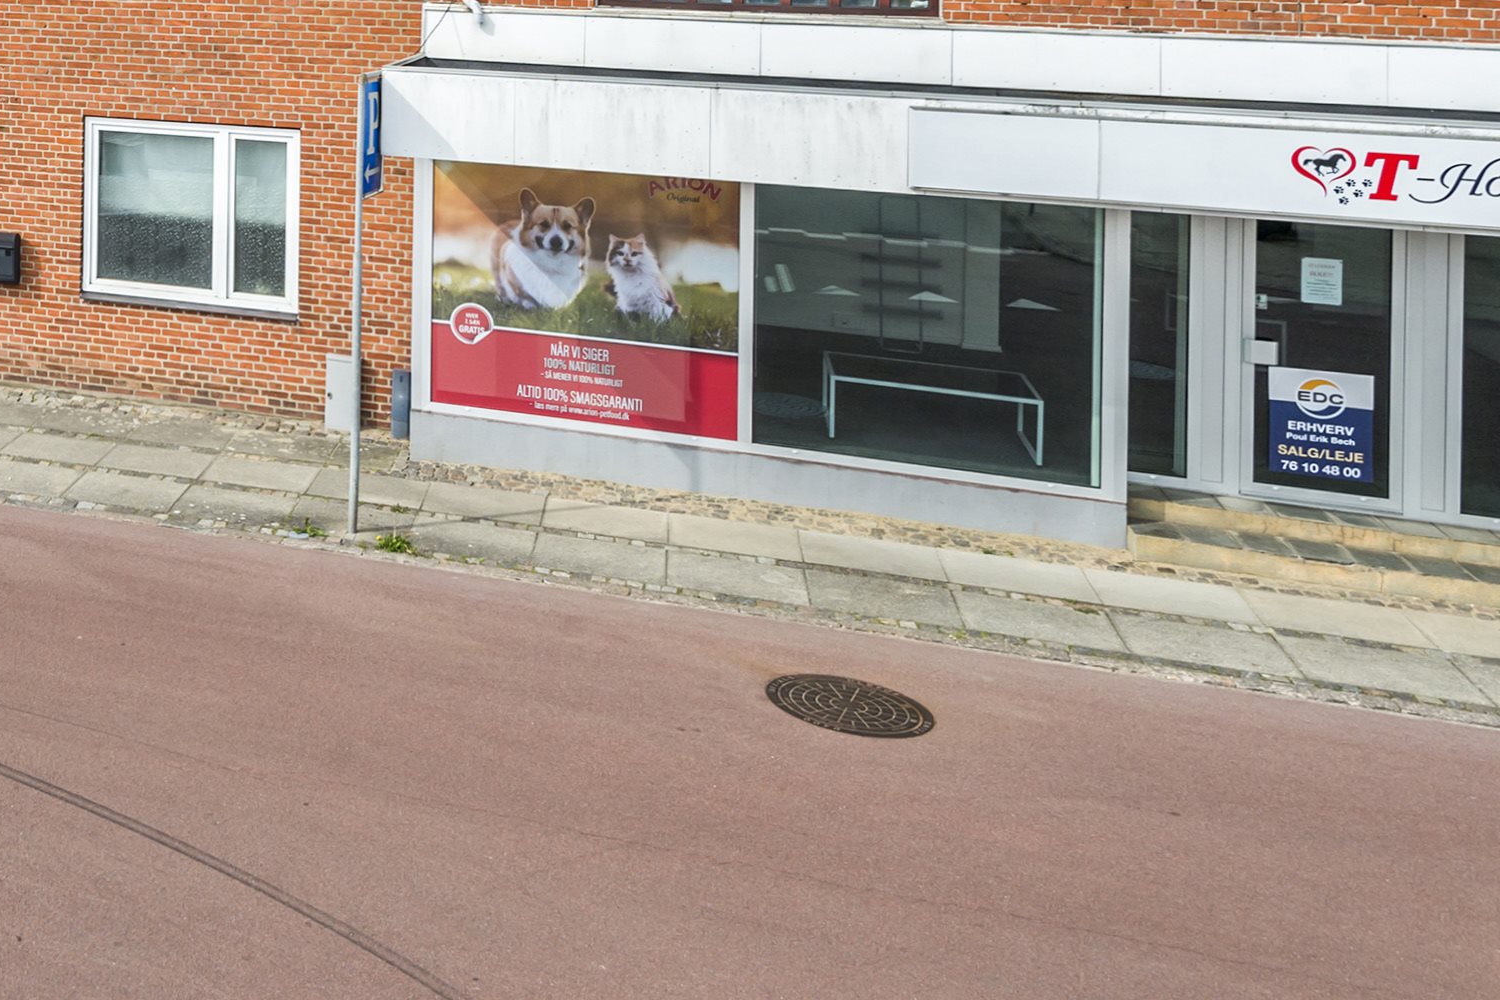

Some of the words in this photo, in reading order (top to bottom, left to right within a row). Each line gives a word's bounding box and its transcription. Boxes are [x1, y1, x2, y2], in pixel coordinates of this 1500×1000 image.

[367, 91, 379, 155] P
[458, 324, 485, 335] GRATIS
[550, 341, 570, 357] NÅR
[571, 346, 581, 359] VI
[582, 347, 610, 362] SIGER
[543, 357, 567, 370] 100%
[568, 360, 616, 376] NATURLIGT
[517, 384, 541, 399] ALTID
[543, 387, 568, 402] 100%
[570, 391, 643, 412] SMAGSGARANTI
[1297, 391, 1344, 405] EDC
[1287, 420, 1355, 436] ERHVERV
[1286, 432, 1308, 441] Poul
[1309, 434, 1329, 443] Erik
[1330, 436, 1356, 446] Bech
[1277, 444, 1365, 464] SALG/LEJE
[1281, 460, 1298, 471] 76
[1302, 462, 1320, 474] 10
[1322, 465, 1341, 476] 48
[1343, 467, 1362, 478] 00
